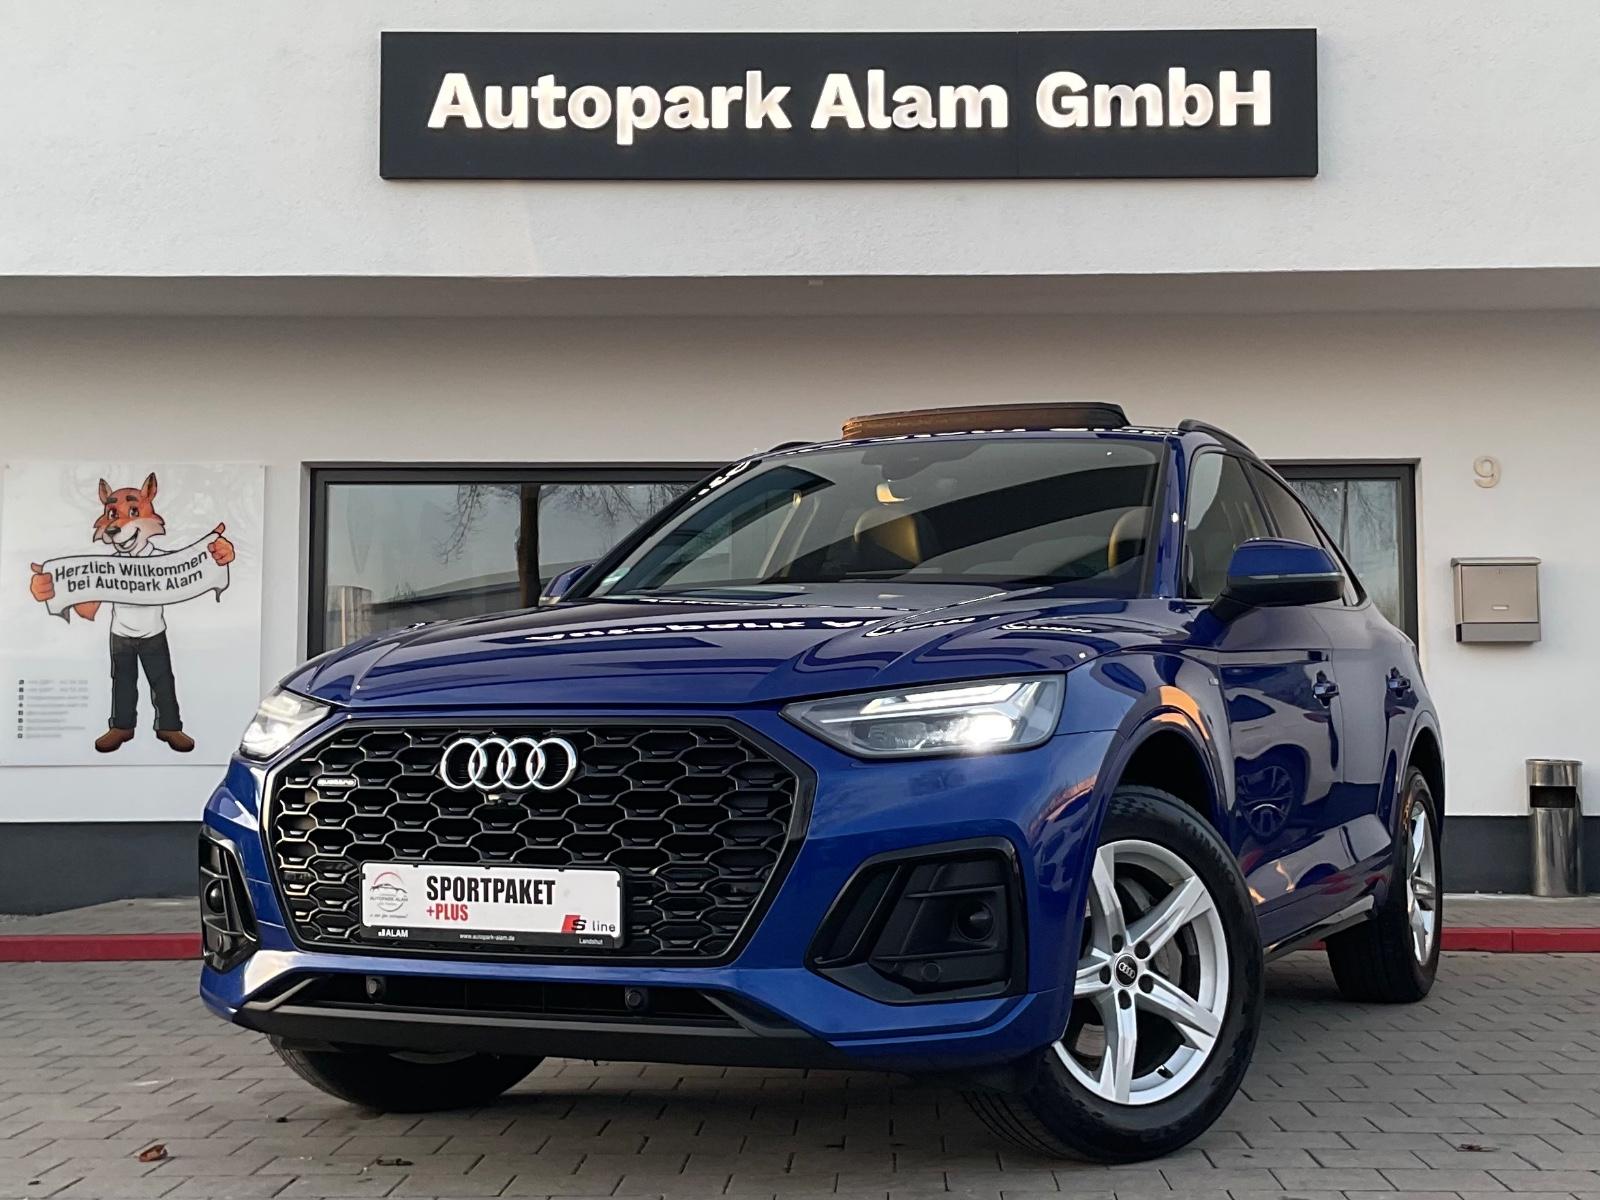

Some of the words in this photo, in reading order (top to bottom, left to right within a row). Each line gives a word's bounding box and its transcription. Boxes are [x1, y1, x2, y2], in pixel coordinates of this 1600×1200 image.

[427, 69, 793, 146] Autopark
[810, 68, 1009, 130] Alam
[1035, 66, 1273, 130] GmbH
[1473, 455, 1502, 488] 9
[55, 561, 116, 582] Herzlich
[118, 551, 208, 577] Willkommen
[67, 577, 91, 592] bei
[95, 577, 161, 593] Autopark
[166, 570, 203, 591] Alam
[426, 875, 556, 905] SPORTPAKET
[427, 903, 469, 921] +PLUS
[386, 929, 409, 938] ALAM
[571, 919, 587, 931] S
[592, 920, 616, 932] line
